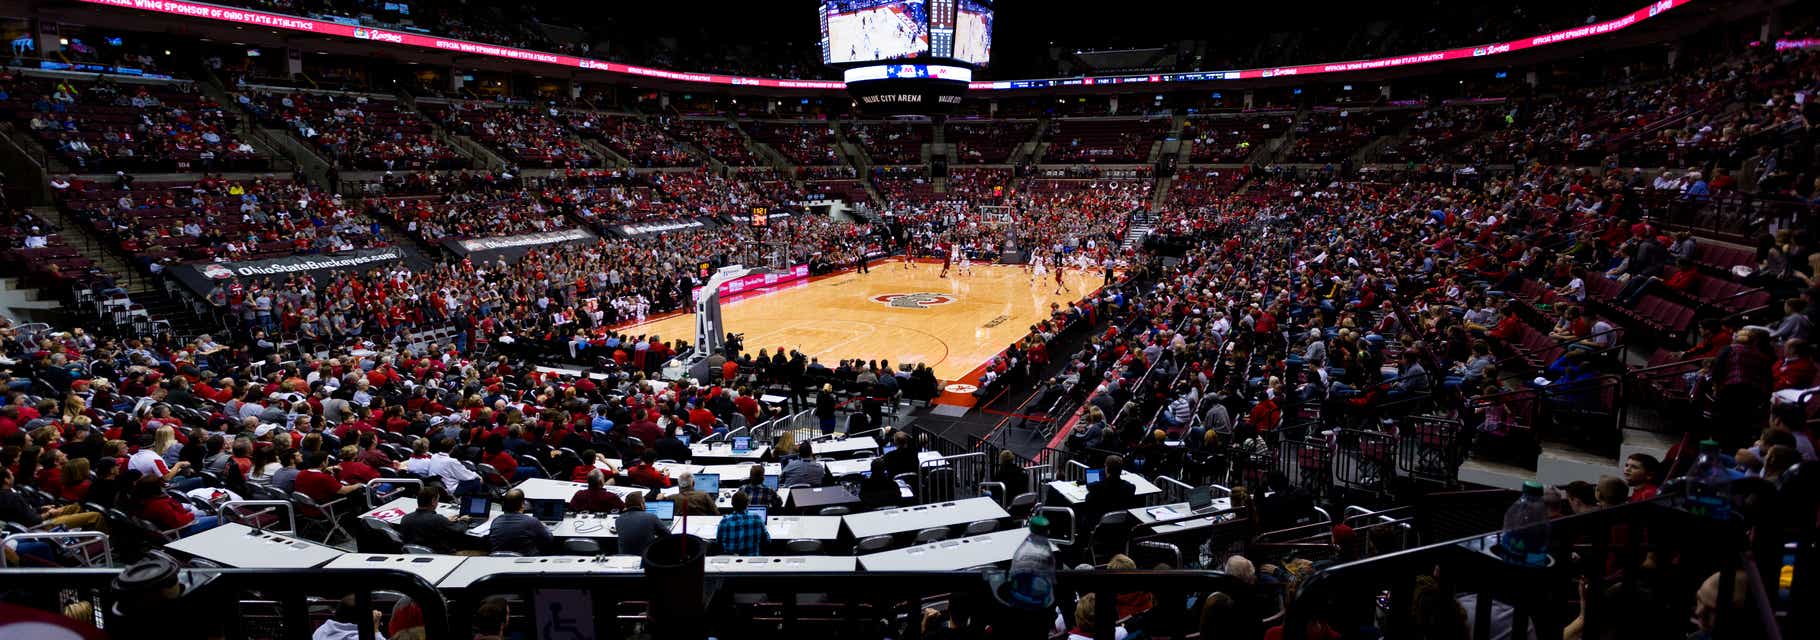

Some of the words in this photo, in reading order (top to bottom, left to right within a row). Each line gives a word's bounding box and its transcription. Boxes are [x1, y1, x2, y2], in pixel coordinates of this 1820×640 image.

[135, 0, 162, 10] WING
[164, 2, 209, 16] SPONSOR
[210, 9, 222, 18] OF
[223, 11, 243, 20] OHIO
[244, 13, 271, 24] STATE
[272, 17, 313, 30] ATHLETICS
[880, 94, 896, 103] CITY
[897, 94, 922, 103] ARENA
[238, 252, 397, 277] OhioStateBuckeyes.com
